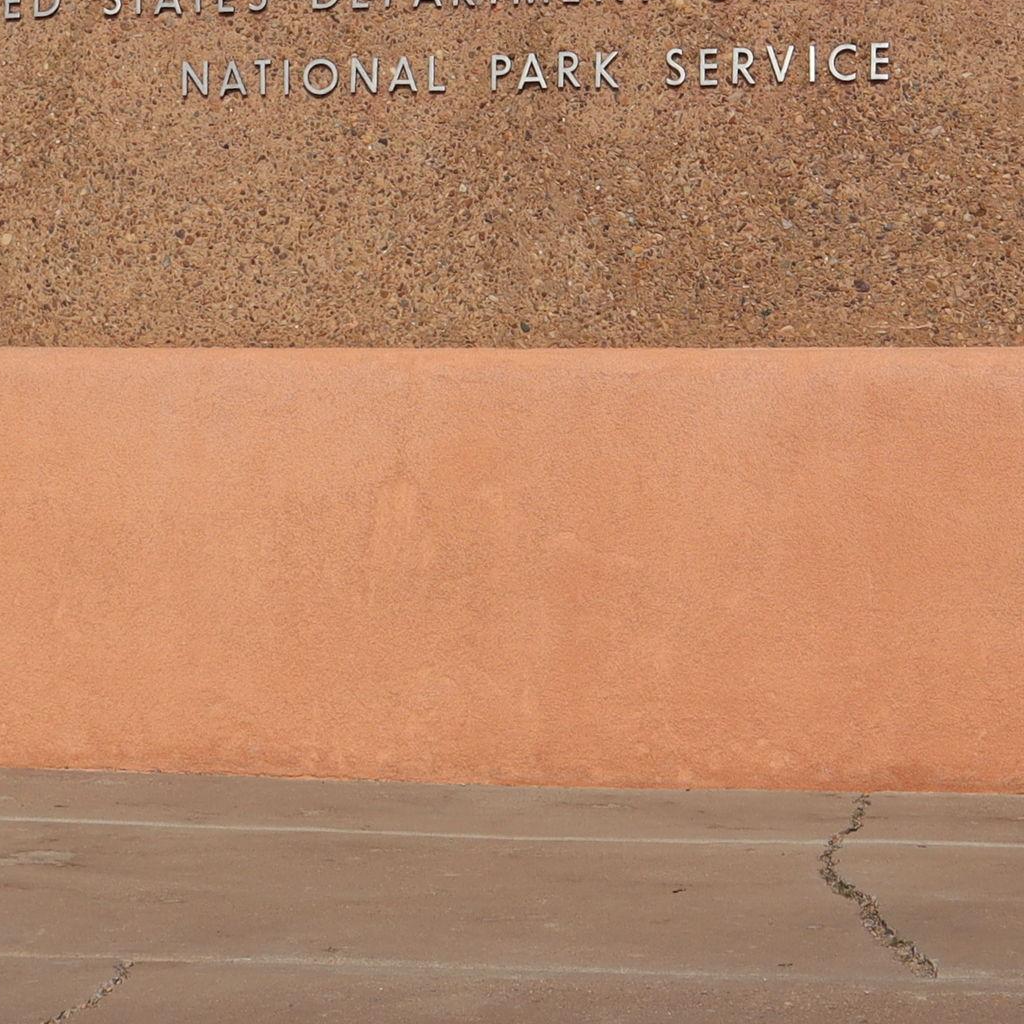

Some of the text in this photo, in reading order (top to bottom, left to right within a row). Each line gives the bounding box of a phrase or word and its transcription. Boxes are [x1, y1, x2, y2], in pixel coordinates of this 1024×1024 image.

[181, 42, 890, 97] NATIONAL PARK SERVICE
